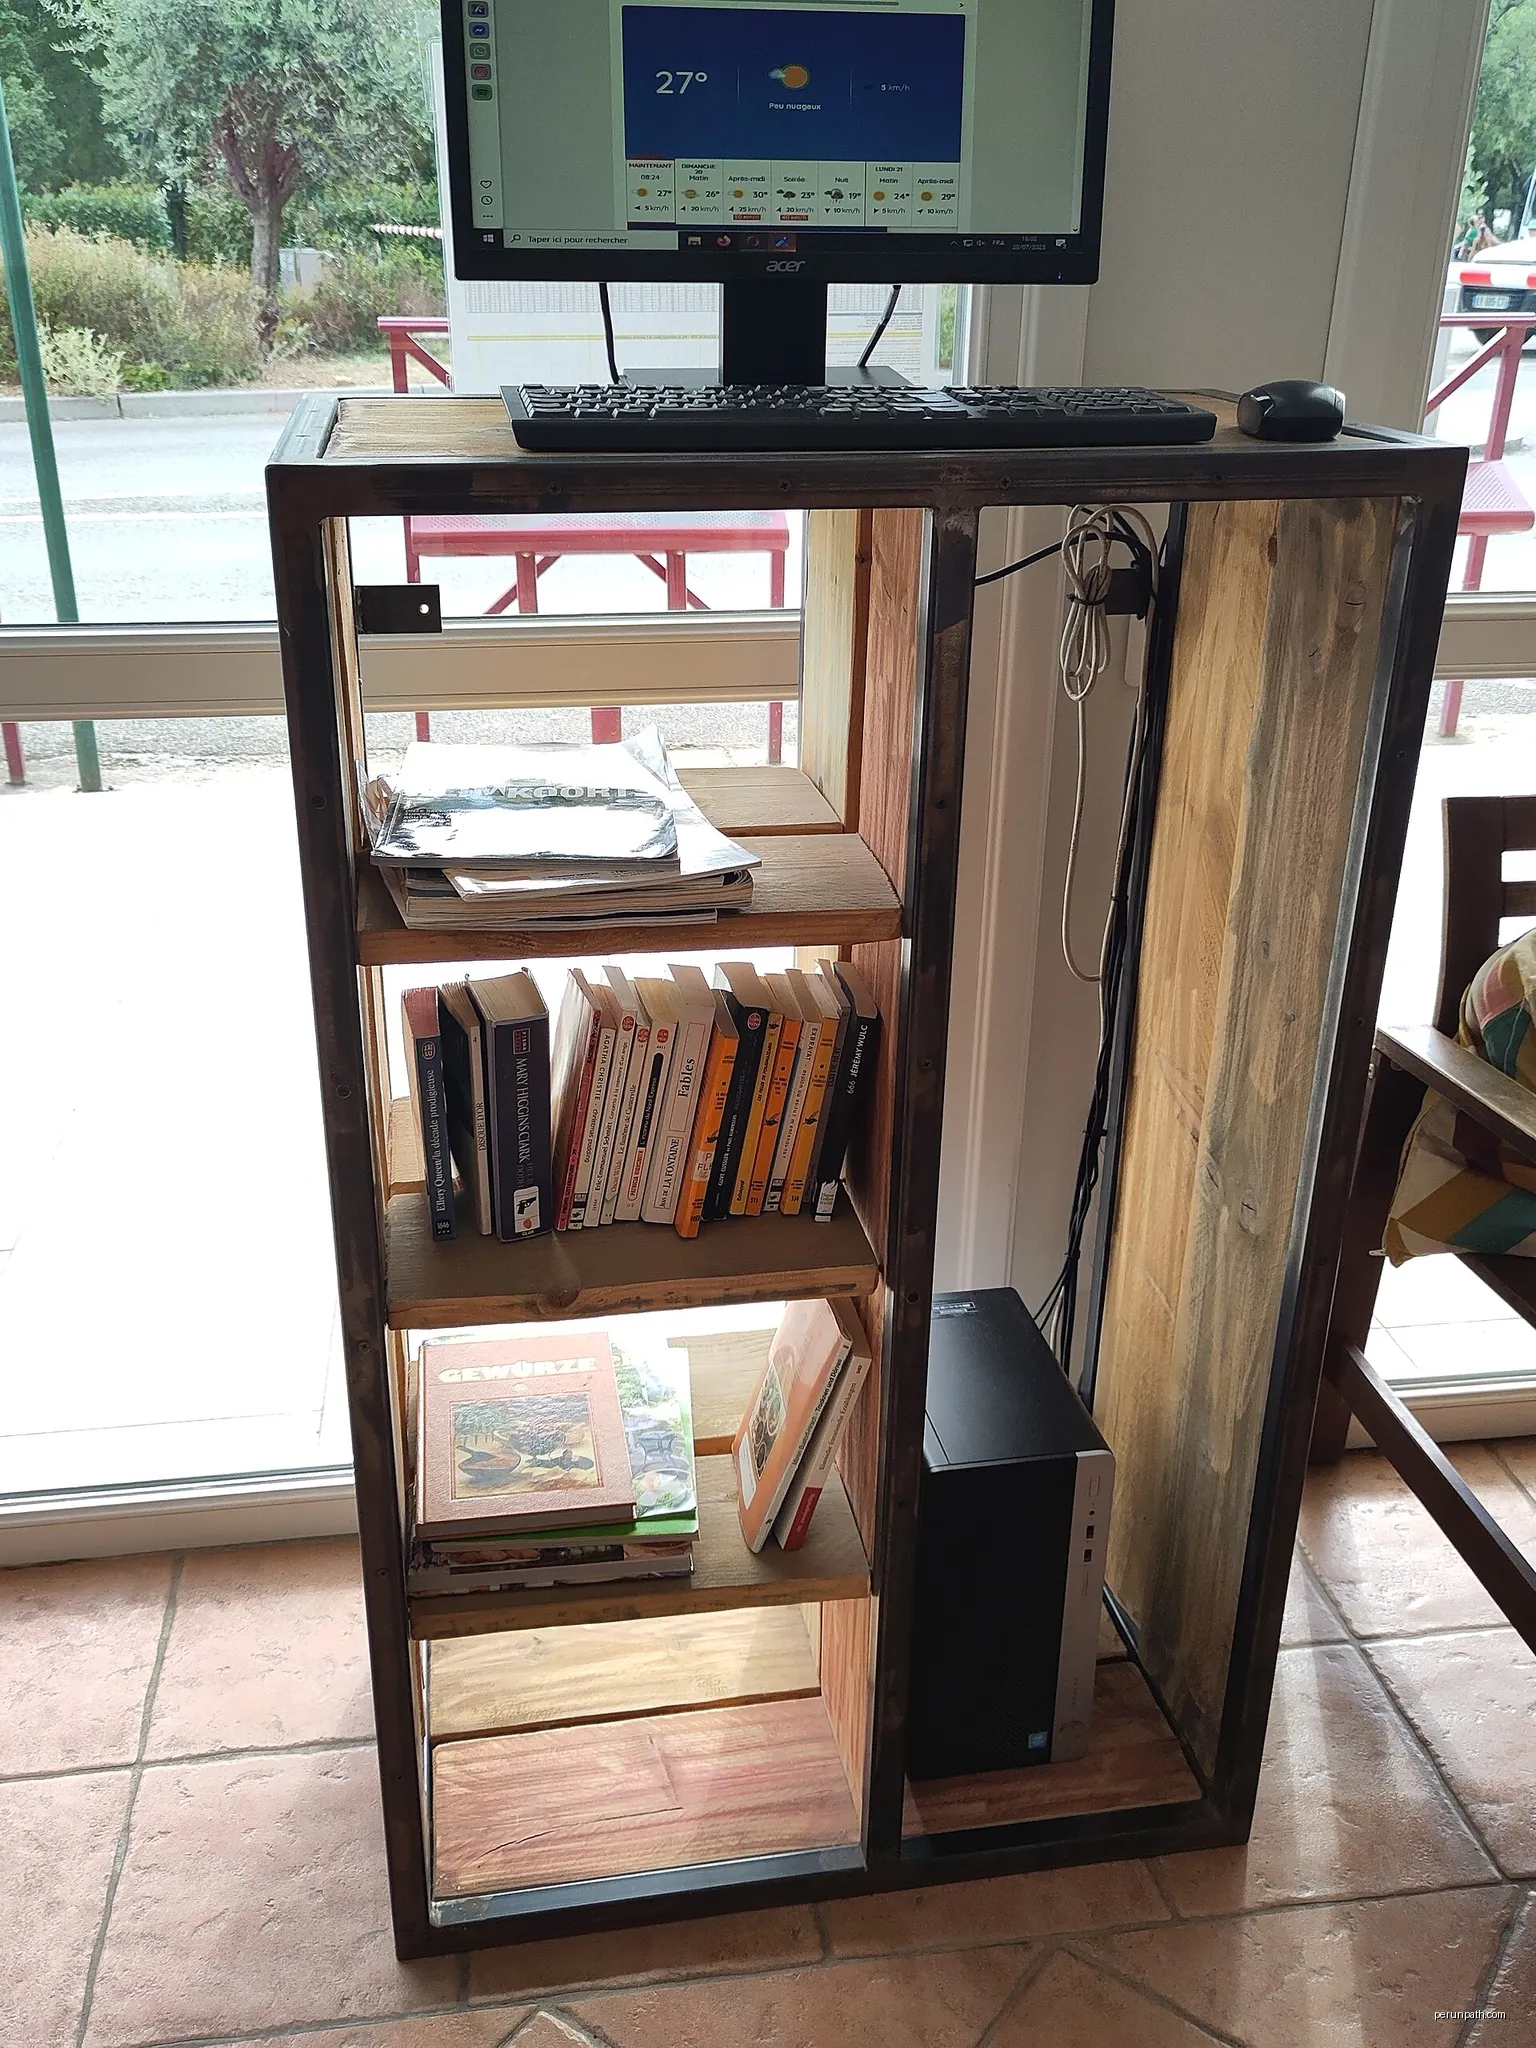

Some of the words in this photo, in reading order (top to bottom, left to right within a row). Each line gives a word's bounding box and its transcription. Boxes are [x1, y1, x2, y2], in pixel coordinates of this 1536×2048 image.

[656, 71, 708, 94] 27°
[888, 84, 910, 92] km/h
[769, 102, 784, 110] Peu
[786, 103, 821, 111] nuageux
[527, 236, 550, 244] Taper
[564, 237, 583, 245] pour
[585, 236, 628, 244] rechercher
[766, 259, 805, 273] acer
[805, 1028, 818, 1062] EXBRAYAT
[857, 1025, 868, 1047] WULC
[600, 1035, 611, 1065] AGATHA
[849, 1047, 864, 1078] JÉRÉMY
[516, 1058, 528, 1085] MARY
[594, 1067, 605, 1101] CHRISTIE
[677, 1058, 695, 1098] Fables
[426, 1070, 441, 1117] prodigieuse
[624, 1084, 636, 1115] Canterville
[846, 1080, 856, 1094] 666
[476, 1102, 484, 1121] D'OR
[517, 1087, 529, 1132] HIGGINS
[430, 1119, 440, 1148] décade
[588, 1108, 598, 1138] christmas
[518, 1132, 530, 1164] CLARK
[584, 1139, 594, 1163] pudding
[594, 1146, 609, 1191] Eric-Emmanuel
[602, 1122, 613, 1145] Schmitt
[617, 1146, 625, 1154] Le
[664, 1138, 680, 1178] FONTAINE
[432, 1149, 445, 1186] Queen/la
[612, 1160, 622, 1176] Wilde
[610, 1177, 618, 1192] Oscar
[662, 1178, 671, 1188] LA
[434, 1188, 446, 1211] Ellery
[438, 1357, 597, 1383] GEWÜRZE
[829, 1359, 842, 1377] Dörren
[825, 1376, 835, 1388] und
